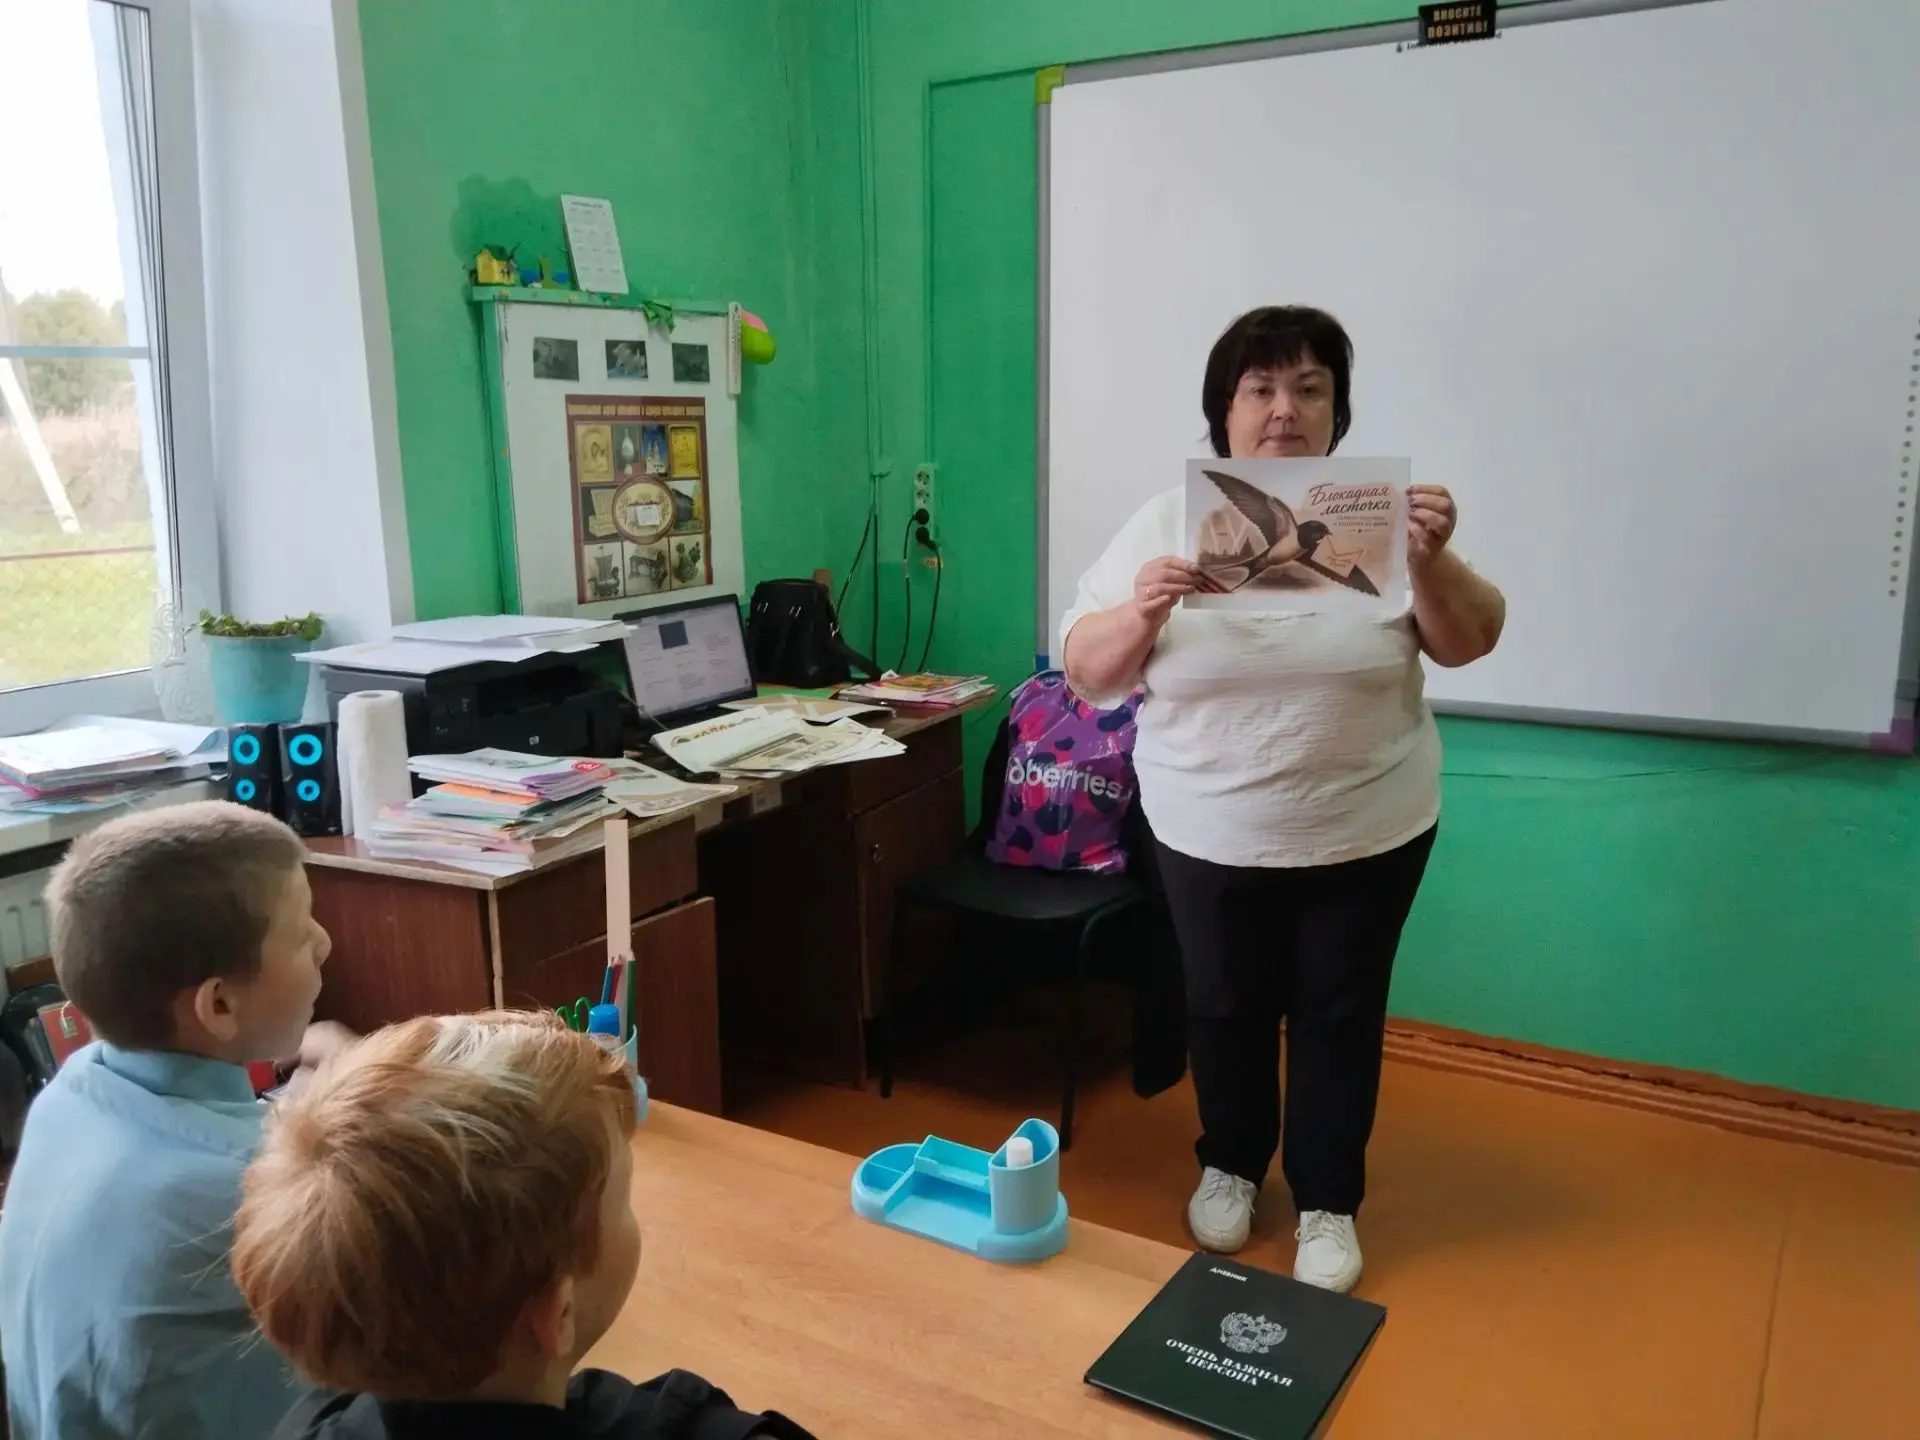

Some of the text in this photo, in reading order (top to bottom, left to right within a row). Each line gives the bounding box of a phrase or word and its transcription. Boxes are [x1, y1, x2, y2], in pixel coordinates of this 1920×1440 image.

[1428, 21, 1488, 39] ПОЗИТИВ!
[1309, 483, 1390, 506] Блокадная
[1320, 500, 1392, 516] ласточка
[1165, 1338, 1293, 1387] ОЧЕНЬ ВАЖНАЯ
[1185, 1355, 1257, 1386] ПЕРСОНА
